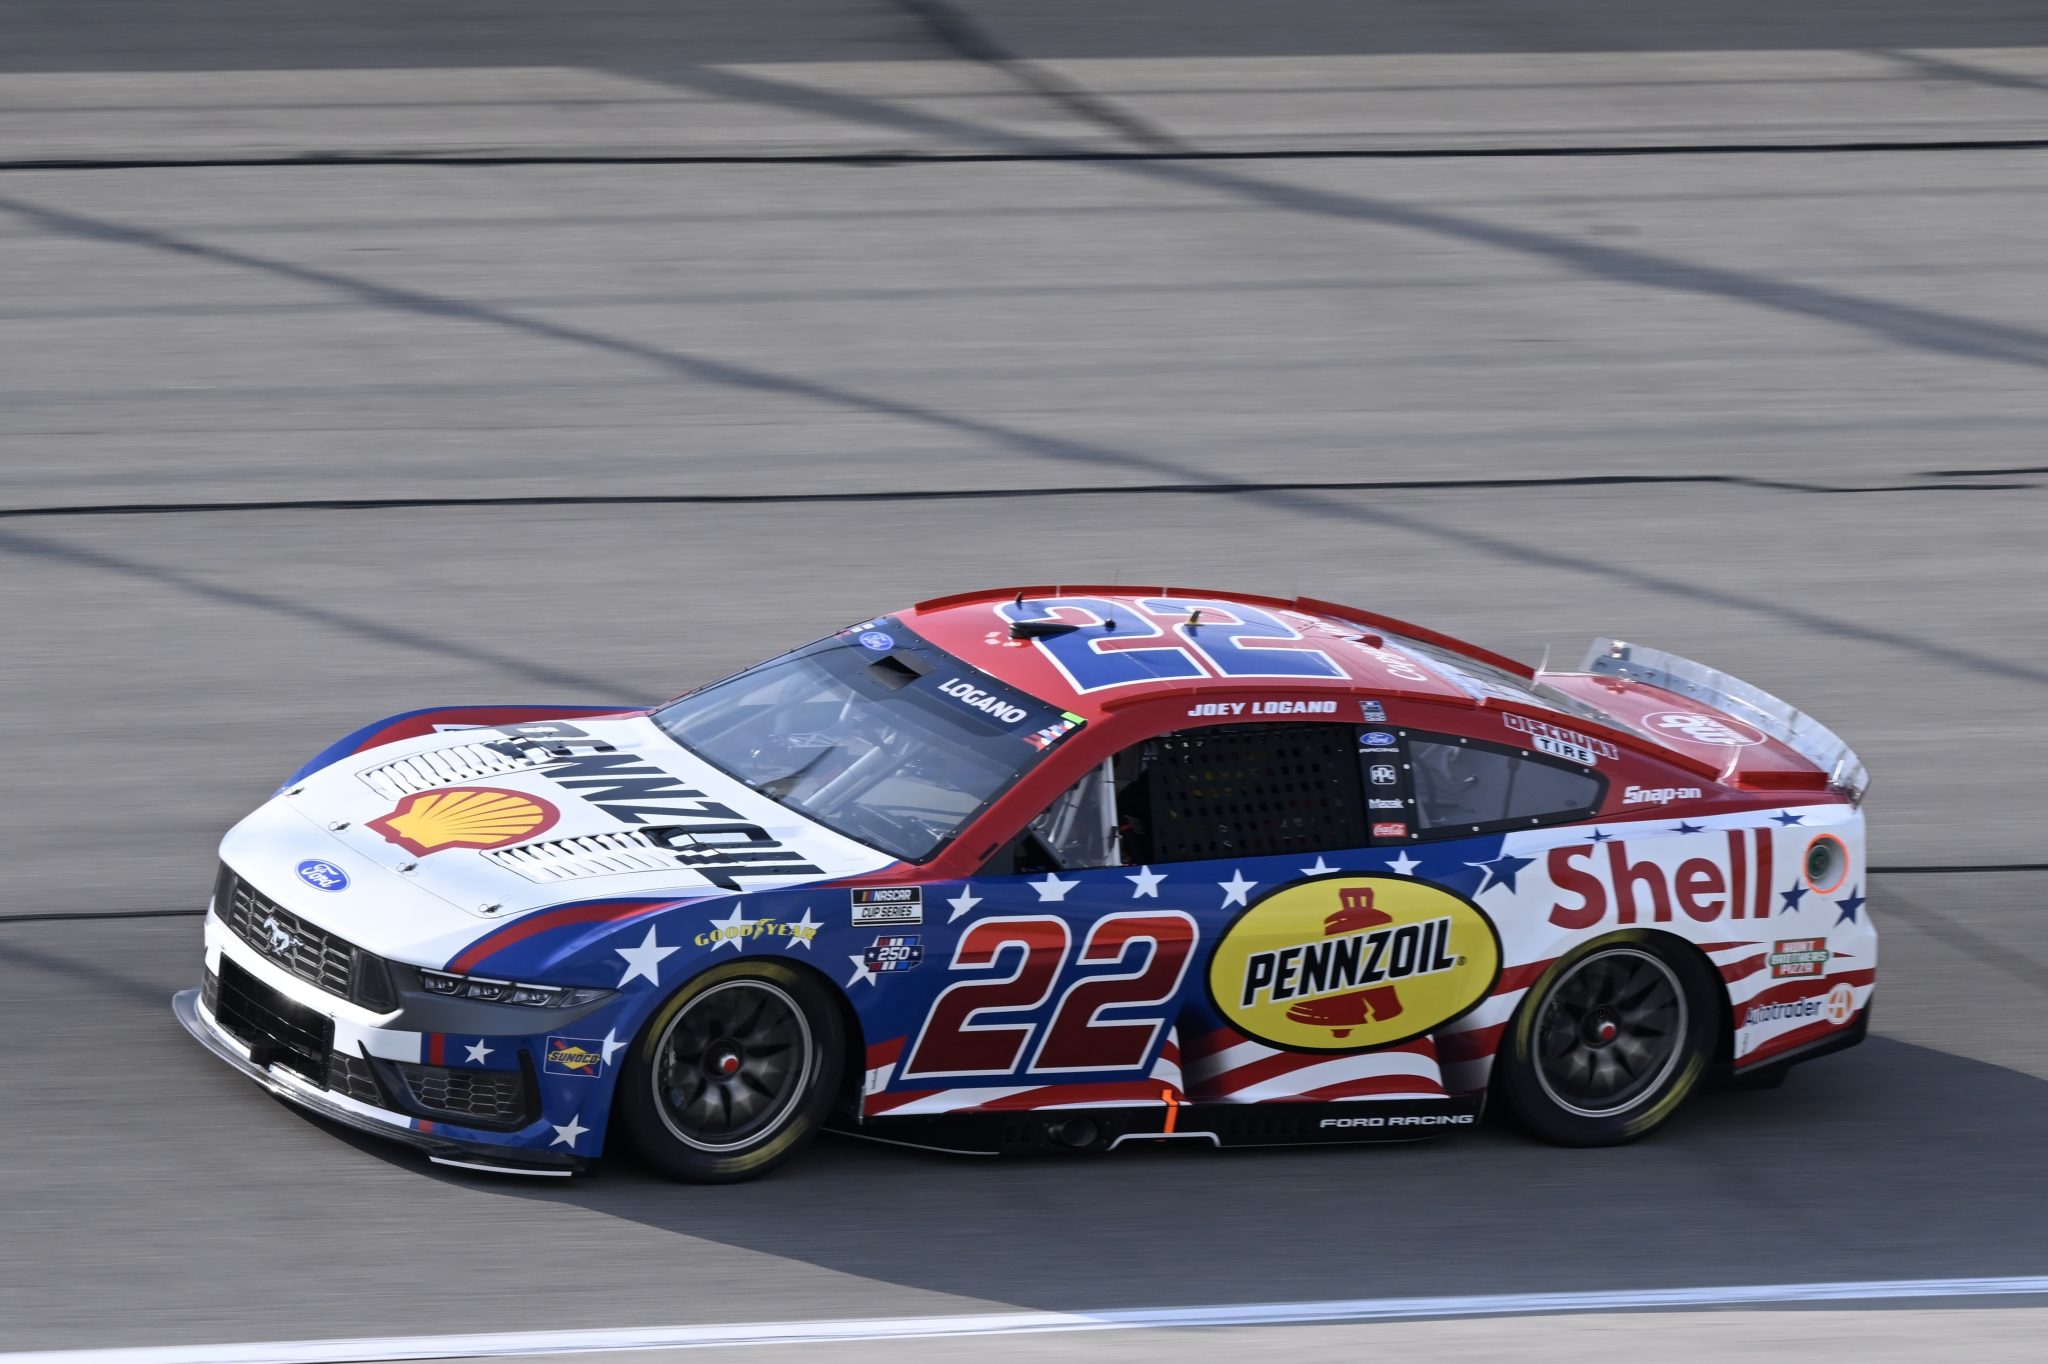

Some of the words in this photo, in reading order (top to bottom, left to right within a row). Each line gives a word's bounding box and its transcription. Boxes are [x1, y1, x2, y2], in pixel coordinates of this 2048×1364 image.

[993, 596, 1352, 695] 22
[938, 678, 1028, 724] LOGANO
[1187, 702, 1246, 717] JOEY
[1251, 701, 1338, 715] LOGANO
[1502, 712, 1620, 760] DISCOUNT
[1540, 738, 1589, 762] TIRE
[1622, 785, 1702, 804] Snap-on
[301, 863, 341, 888] Ford
[1547, 827, 1773, 930] Shell
[873, 890, 912, 901] NASCAR
[862, 907, 880, 918] CUP
[881, 905, 912, 917] SERIES
[694, 918, 817, 947] GOODYEAR
[877, 946, 911, 961] 250
[1240, 915, 1457, 1010] PENNZOIL
[899, 909, 1200, 1081] 22
[550, 1050, 600, 1065] SUNOCO
[1320, 1118, 1384, 1128] FORD
[1388, 1115, 1474, 1126] RACING
